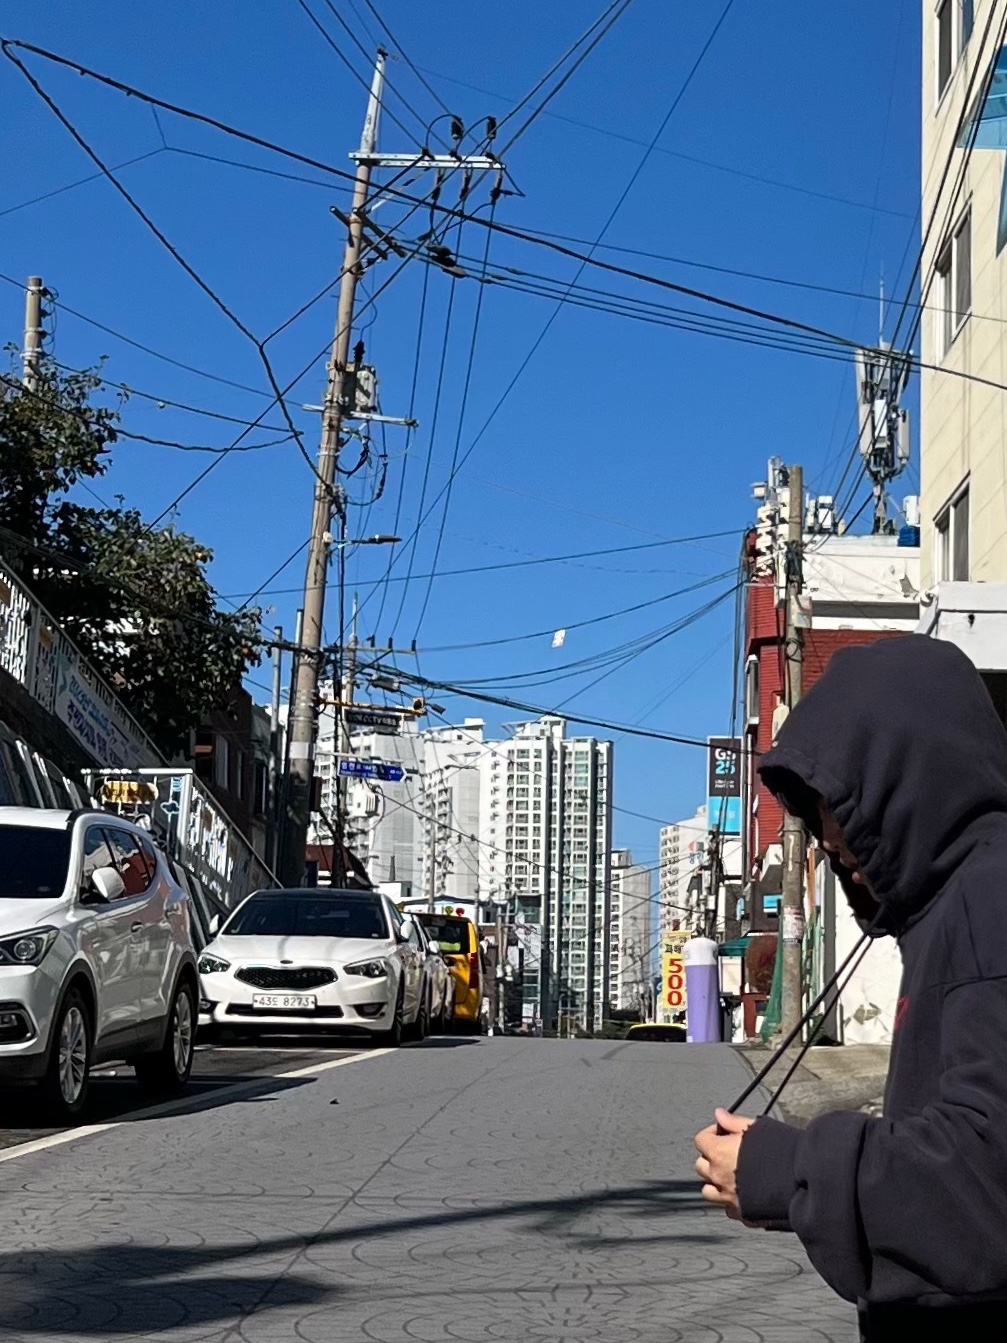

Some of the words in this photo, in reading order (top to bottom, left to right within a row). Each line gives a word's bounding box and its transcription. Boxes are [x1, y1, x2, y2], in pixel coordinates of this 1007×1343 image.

[714, 748, 736, 760] GS
[715, 760, 736, 774] 25
[668, 958, 683, 1006] 500
[283, 996, 310, 1007] 8273
